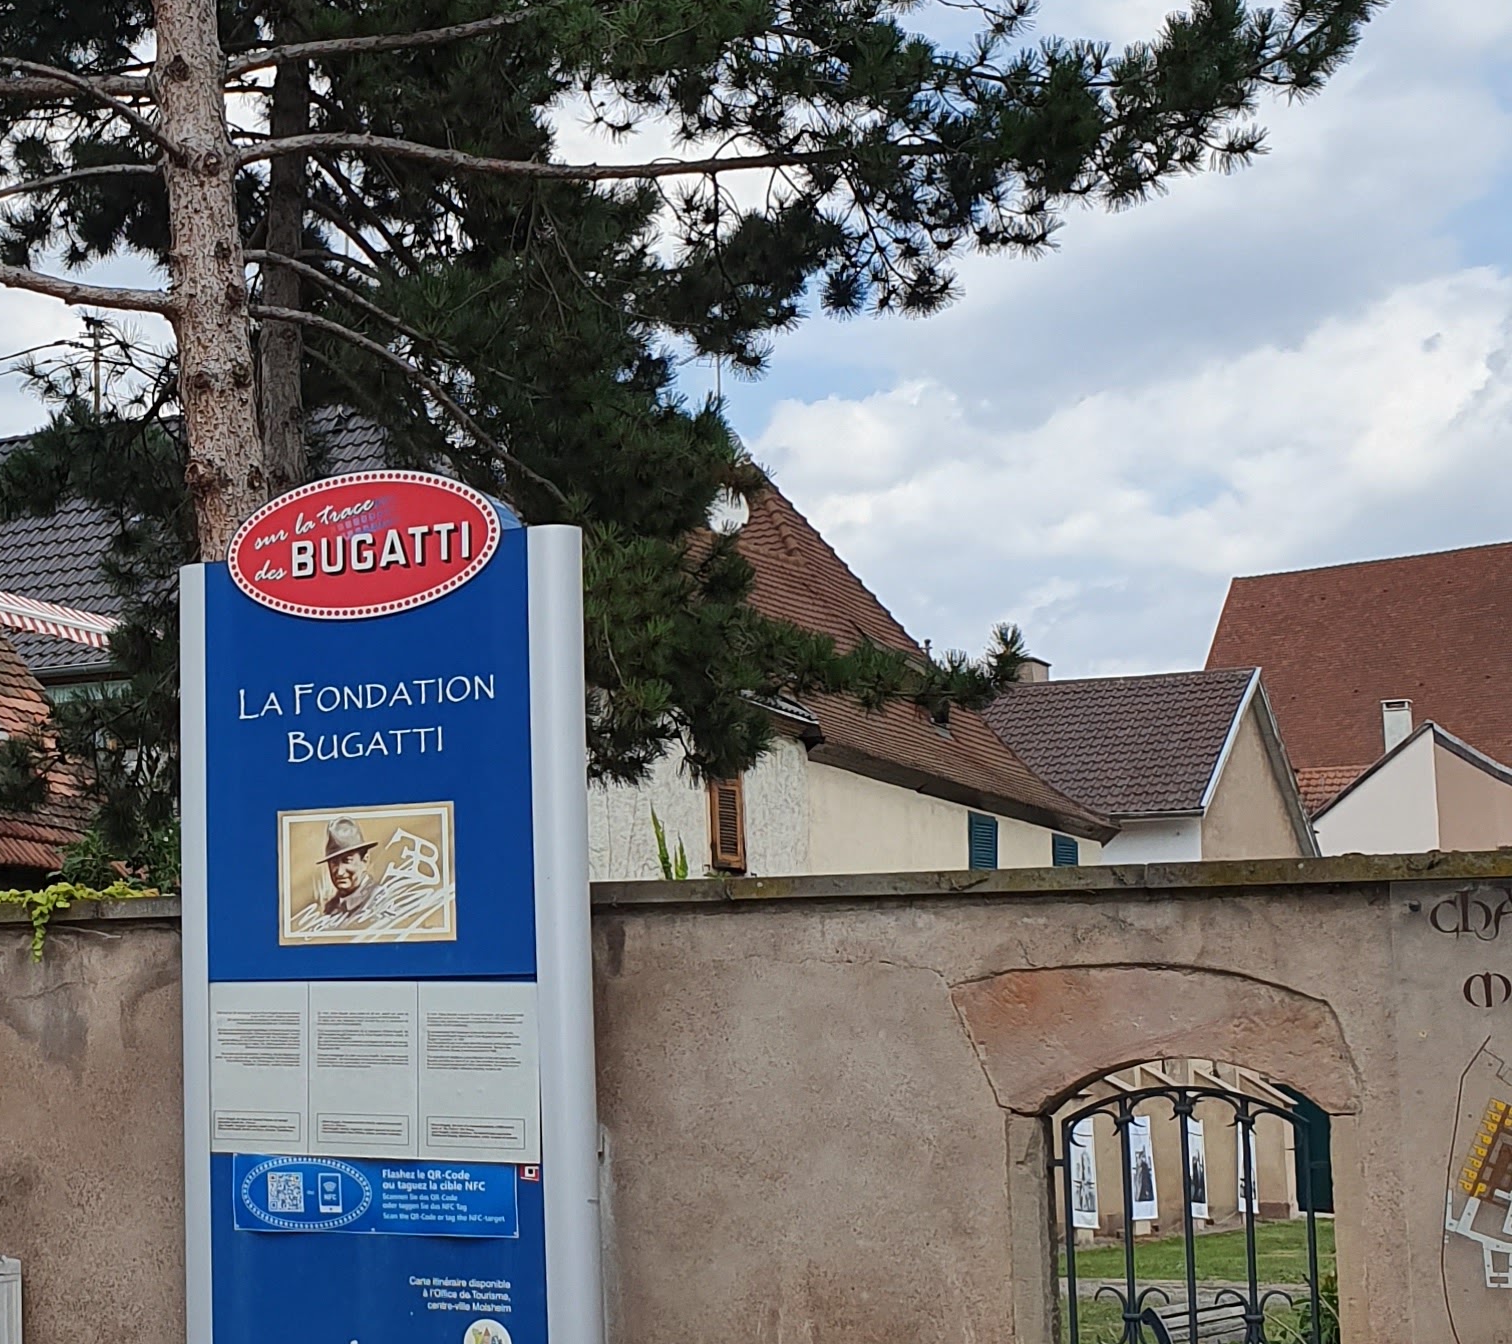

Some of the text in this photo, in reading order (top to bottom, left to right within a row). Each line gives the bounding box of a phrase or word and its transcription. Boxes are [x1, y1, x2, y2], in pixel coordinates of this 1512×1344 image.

[254, 499, 375, 550] sur la trace
[254, 521, 471, 582] des BUGATTI
[287, 726, 443, 763] BUGATTI
[382, 1169, 470, 1180] Flashez le QR-Code
[398, 1181, 427, 1192] taguez
[429, 1181, 438, 1190] la
[440, 1181, 462, 1191] cible
[465, 1181, 486, 1192] NFC
